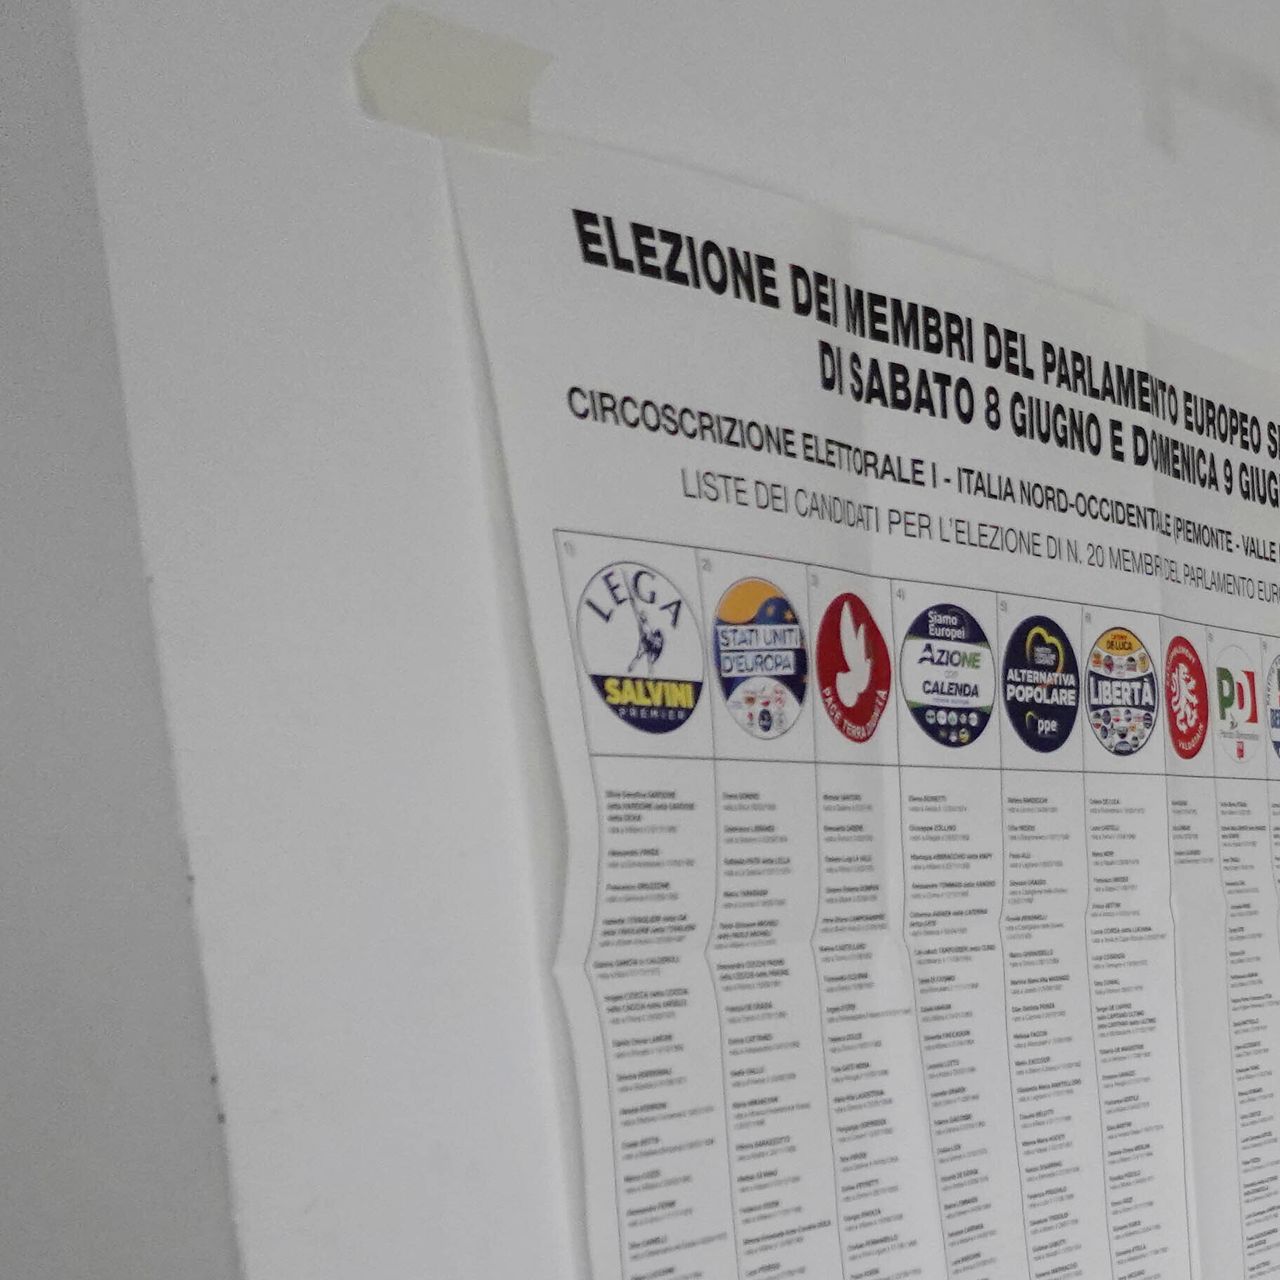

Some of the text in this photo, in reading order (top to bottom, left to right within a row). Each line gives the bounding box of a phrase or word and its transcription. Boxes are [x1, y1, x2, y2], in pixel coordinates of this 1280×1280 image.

[572, 208, 780, 309] ELEZIONE
[789, 263, 838, 328] DEI
[845, 284, 974, 363] MEMBRI
[984, 322, 1034, 380] DEL
[1042, 340, 1178, 426] PARLAMENTO
[1183, 390, 1261, 454] EUROPEO
[819, 340, 843, 395] DI
[850, 351, 975, 425] SABATO
[985, 386, 1001, 431] 8
[1009, 391, 1101, 456] GIUGNO
[1109, 418, 1125, 463] E
[1132, 424, 1219, 492] DOMENICA
[1223, 459, 1233, 495] 9
[566, 385, 797, 460] CIRCOSCRIZIONE
[802, 431, 926, 487] ELETTORALE
[931, 461, 937, 489] I
[957, 467, 1016, 504] ITALIA
[1020, 477, 1172, 537] NORD-OCCIDENTALE
[1174, 516, 1233, 553] (PIEMONTE
[1242, 534, 1276, 563] VALLE
[680, 467, 749, 507] LISTE
[754, 480, 788, 513] DEI
[795, 488, 880, 534] CANDIDATI
[888, 508, 931, 542] PER
[939, 516, 1041, 557] L'ELEZIONE
[1047, 535, 1062, 560] DI
[1067, 540, 1082, 564] N.
[1088, 543, 1104, 568] 20
[1183, 563, 1254, 601] PARLAMENTO
[585, 570, 682, 629] LEGA
[928, 610, 958, 626] Siamo
[928, 623, 966, 641] Europei
[917, 643, 982, 669] AZIONE
[922, 680, 979, 698] CALENDA
[1007, 668, 1075, 687] ALTERNATIVA
[604, 677, 695, 709] SALVINI
[1007, 684, 1076, 706] POPOLARE
[1089, 677, 1154, 706] LIBERTÀ
[1038, 719, 1057, 735] ppe
